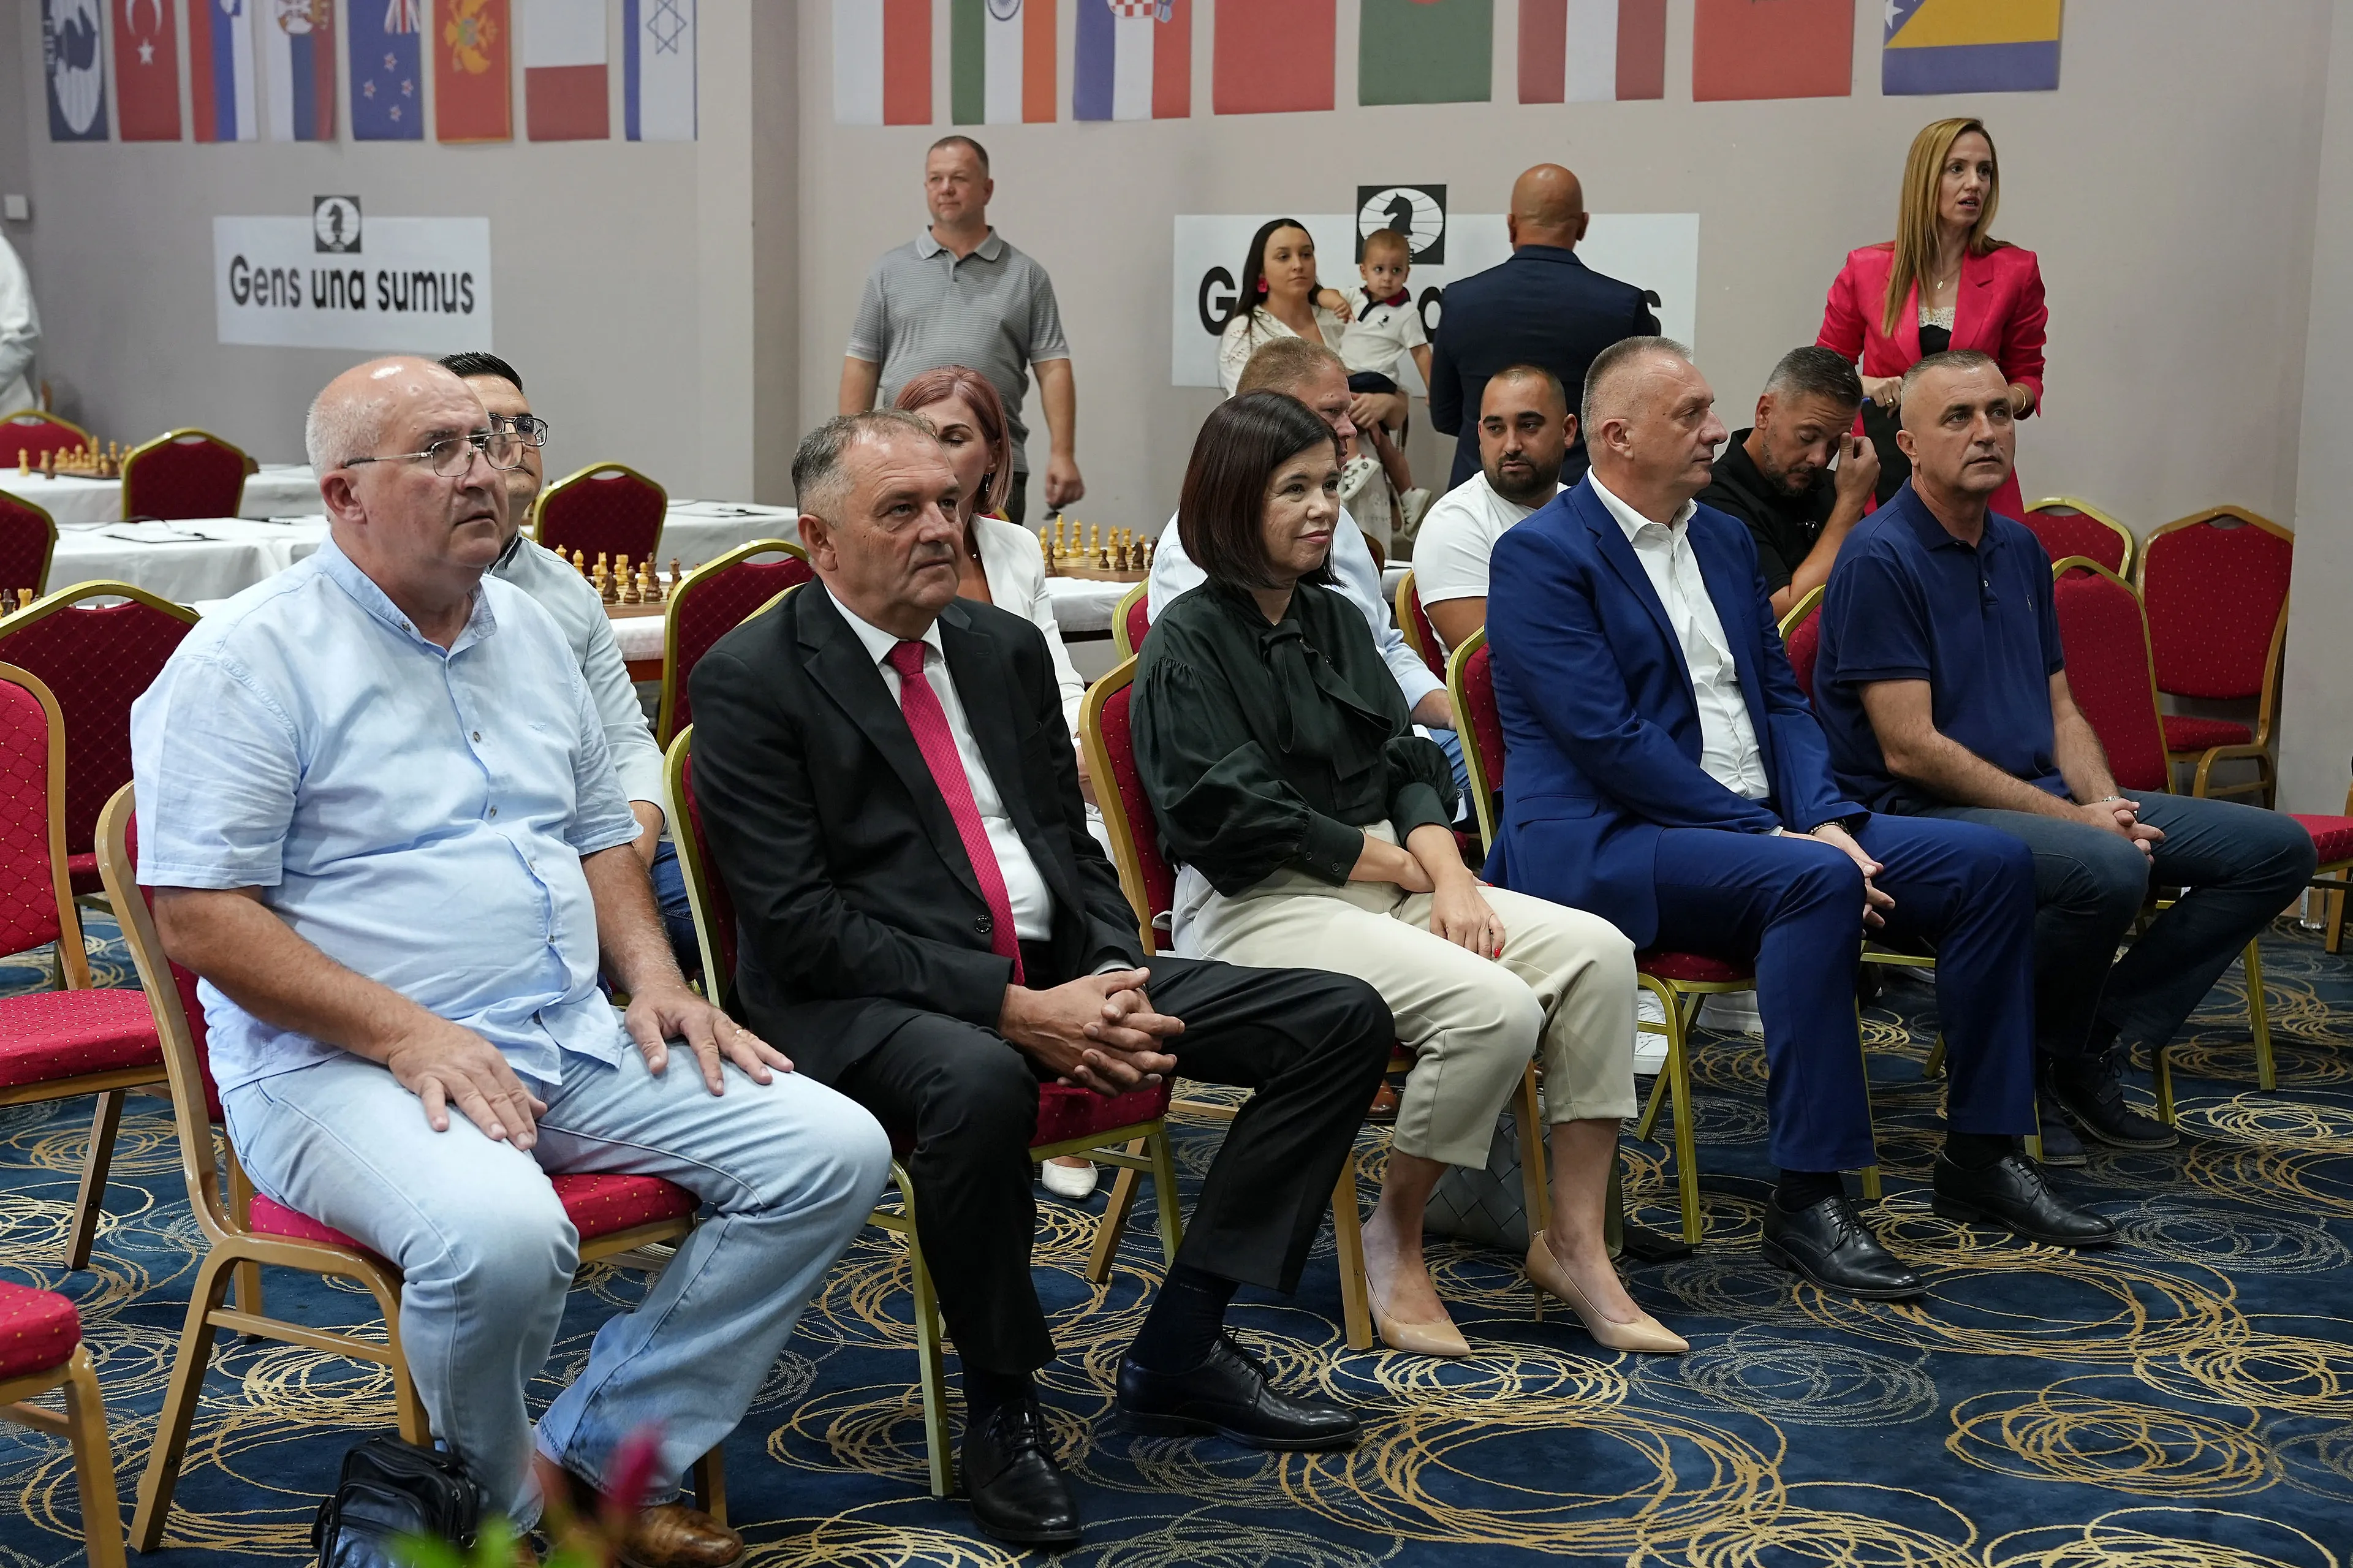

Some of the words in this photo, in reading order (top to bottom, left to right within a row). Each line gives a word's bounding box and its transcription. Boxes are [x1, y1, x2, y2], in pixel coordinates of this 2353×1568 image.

[230, 254, 301, 308] Gens
[311, 269, 365, 309] una
[377, 270, 474, 314] sumus
